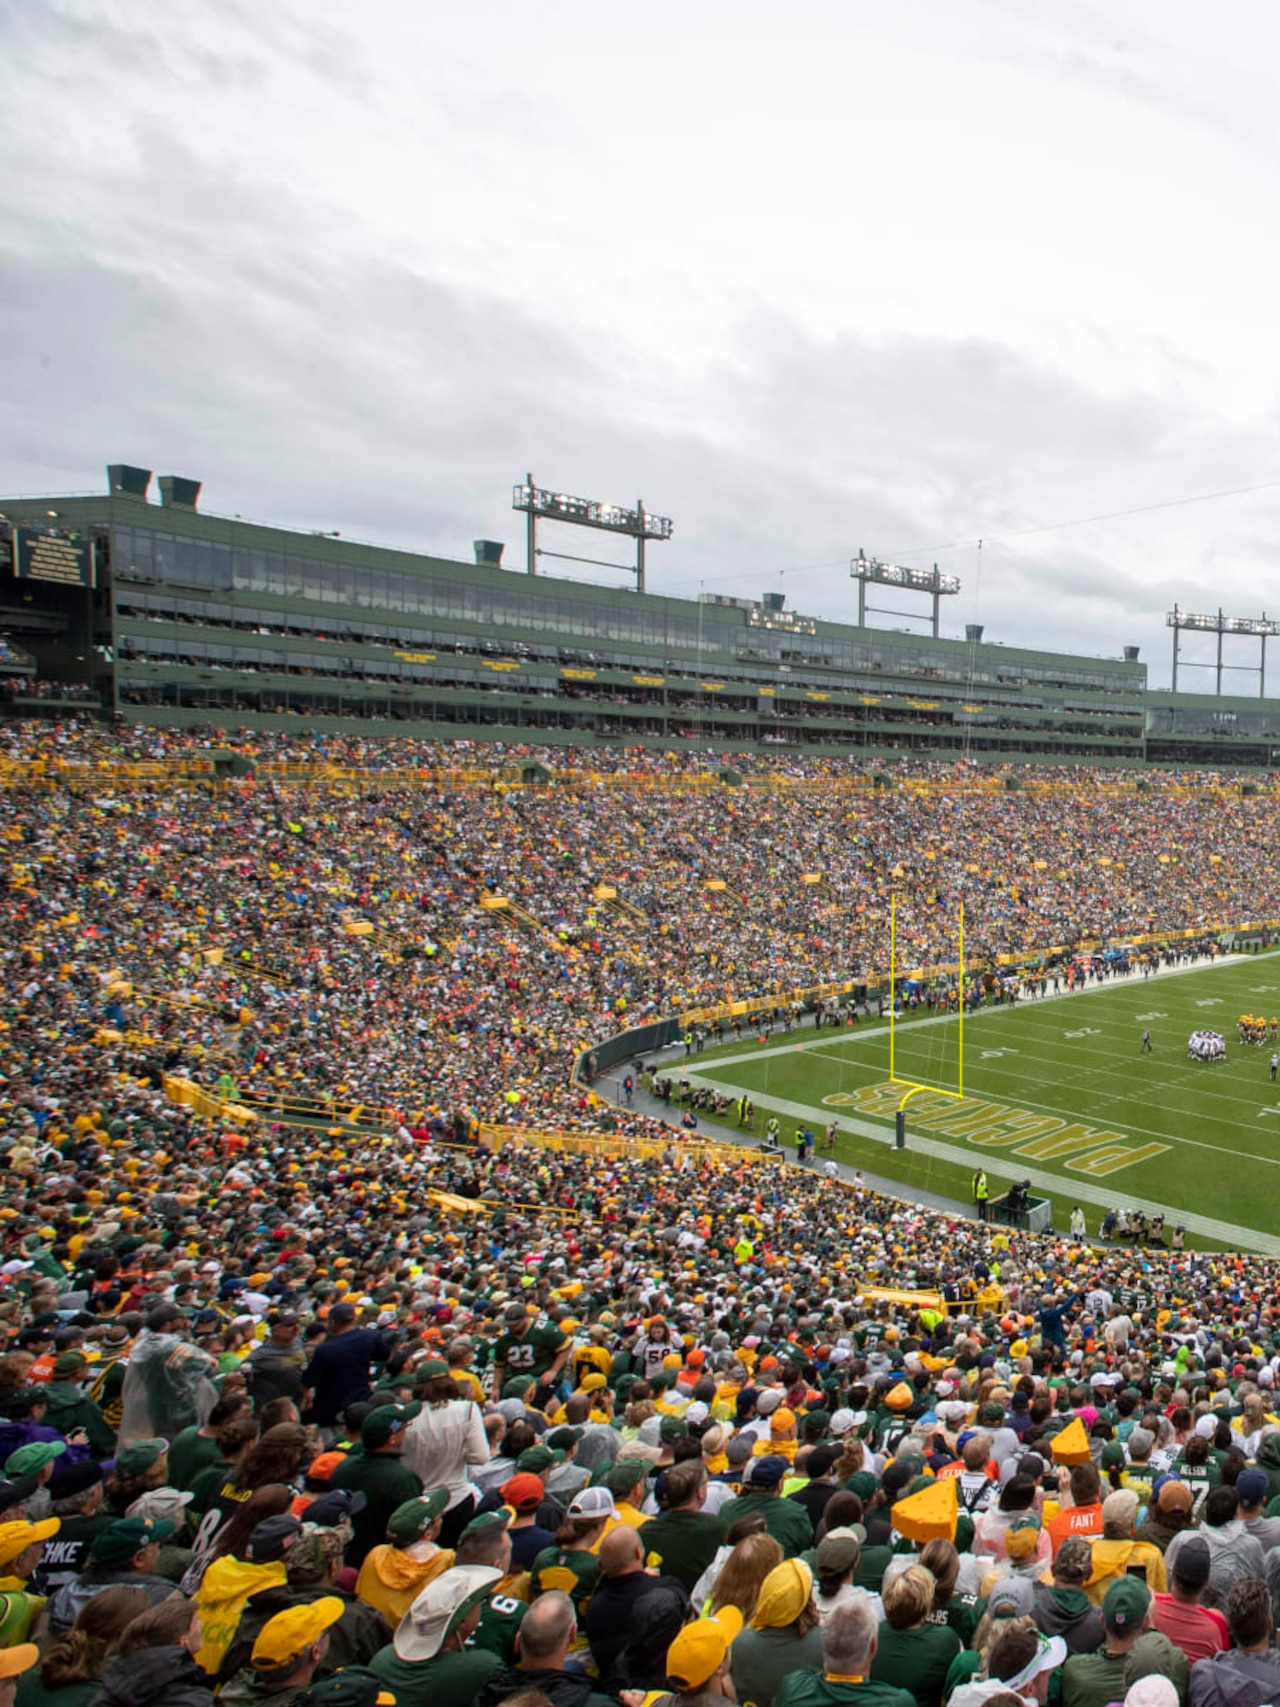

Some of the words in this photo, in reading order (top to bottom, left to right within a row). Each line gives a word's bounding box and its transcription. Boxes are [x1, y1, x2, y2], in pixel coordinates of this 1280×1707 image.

[820, 1081, 1174, 1178] PACKERS
[508, 1344, 535, 1367] 23
[1180, 1465, 1207, 1476] NELSON
[1070, 1512, 1096, 1529] FANT
[42, 1541, 84, 1564] HKE
